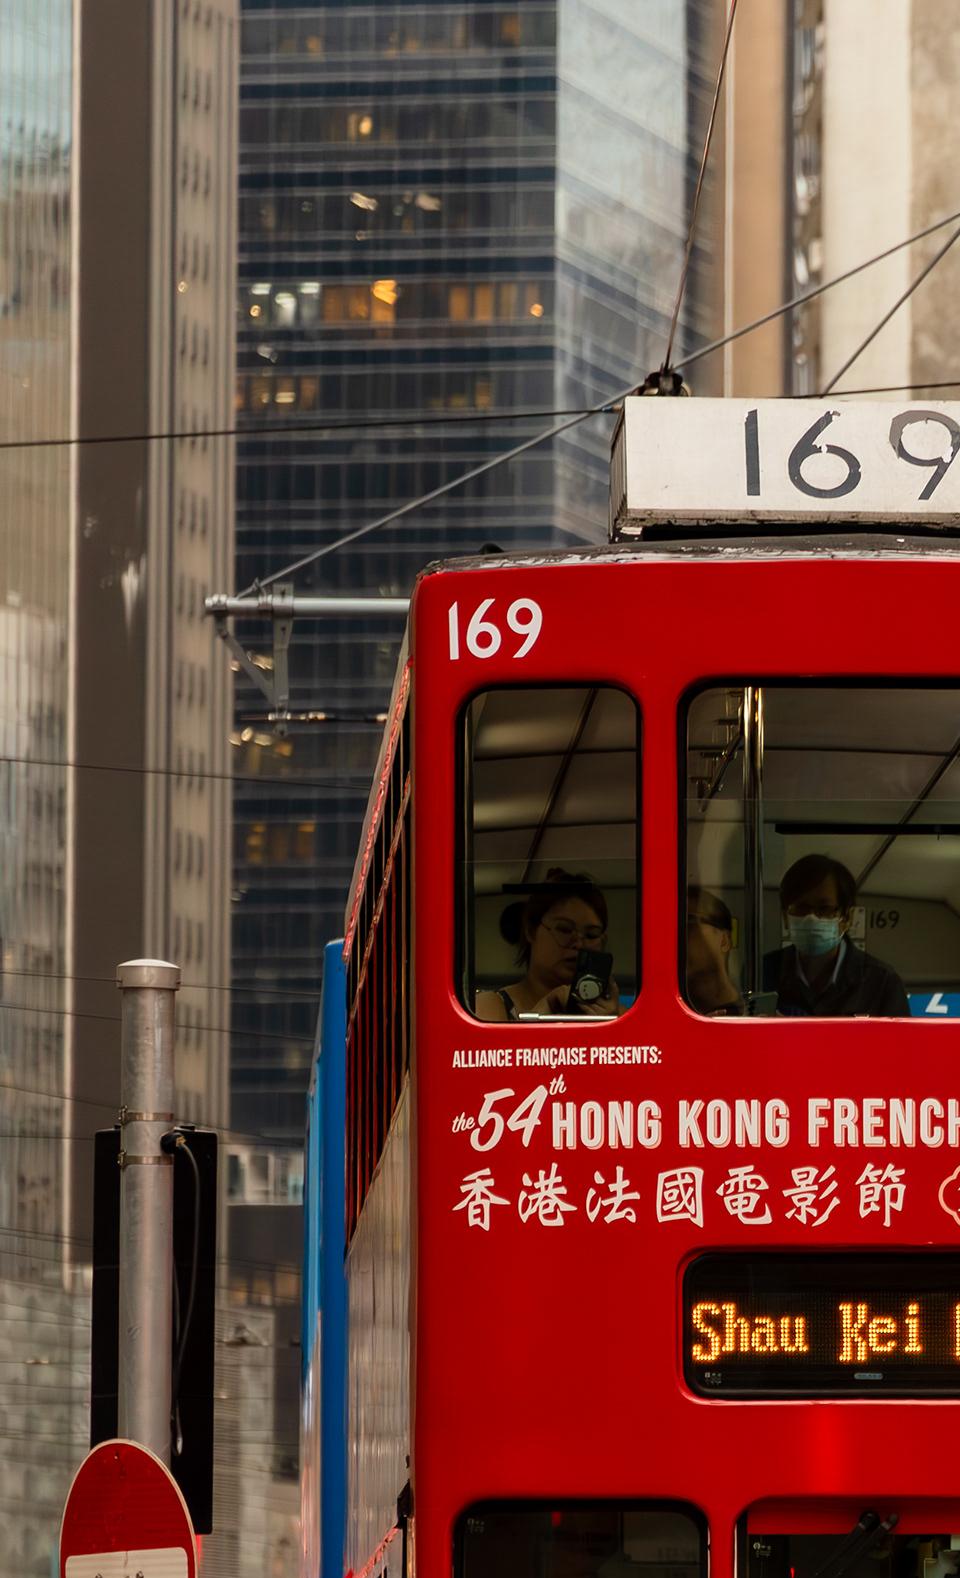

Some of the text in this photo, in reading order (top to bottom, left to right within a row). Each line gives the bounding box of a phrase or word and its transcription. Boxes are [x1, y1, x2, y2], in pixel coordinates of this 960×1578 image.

[447, 597, 543, 661] 169
[869, 909, 900, 929] 169
[452, 1046, 662, 1069] ALLIANCE FRANÇAISE PRESENTS:
[451, 1112, 475, 1133] the
[551, 1100, 662, 1150] HONG
[678, 1099, 789, 1148] KONG
[452, 1162, 907, 1232] 香港法國電影節
[691, 1302, 808, 1361] Shau
[838, 1302, 922, 1361] Kei
